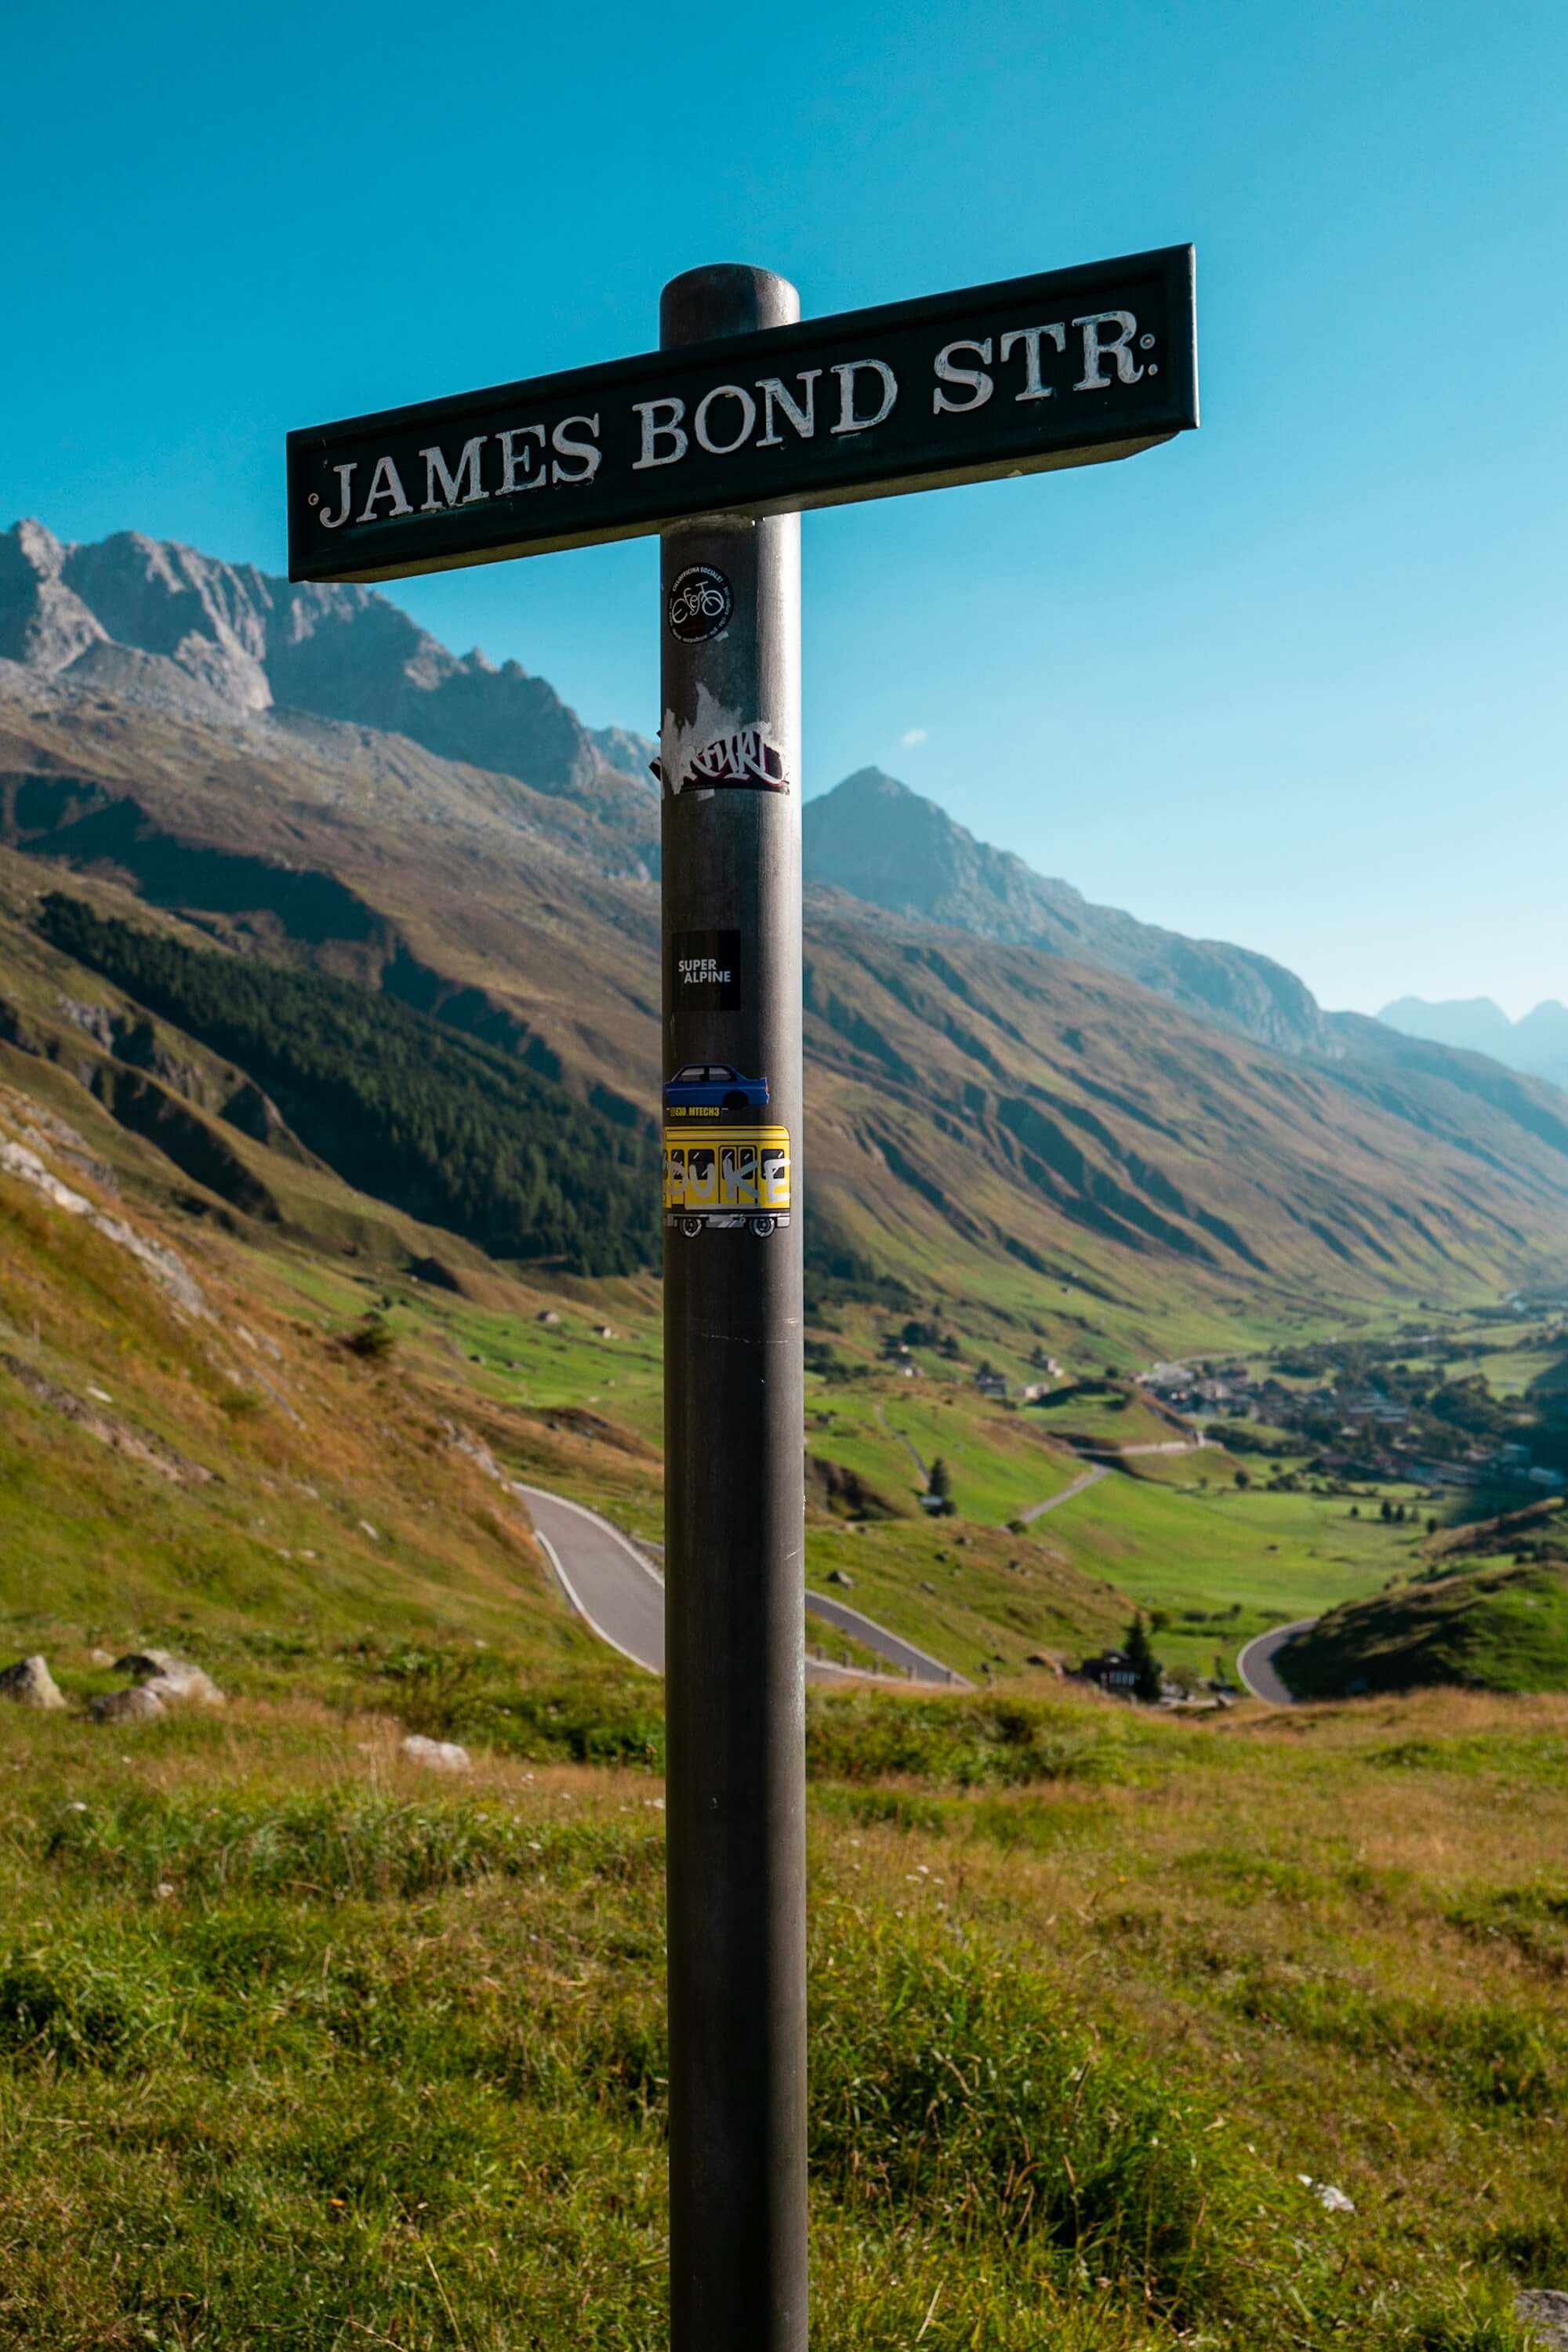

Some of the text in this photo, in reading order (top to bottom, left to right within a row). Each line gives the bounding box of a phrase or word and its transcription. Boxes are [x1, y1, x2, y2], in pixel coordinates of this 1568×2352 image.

[319, 310, 1158, 528] JAMES BOND STR.
[678, 958, 717, 972] SUPER
[684, 971, 731, 983] ALPINE
